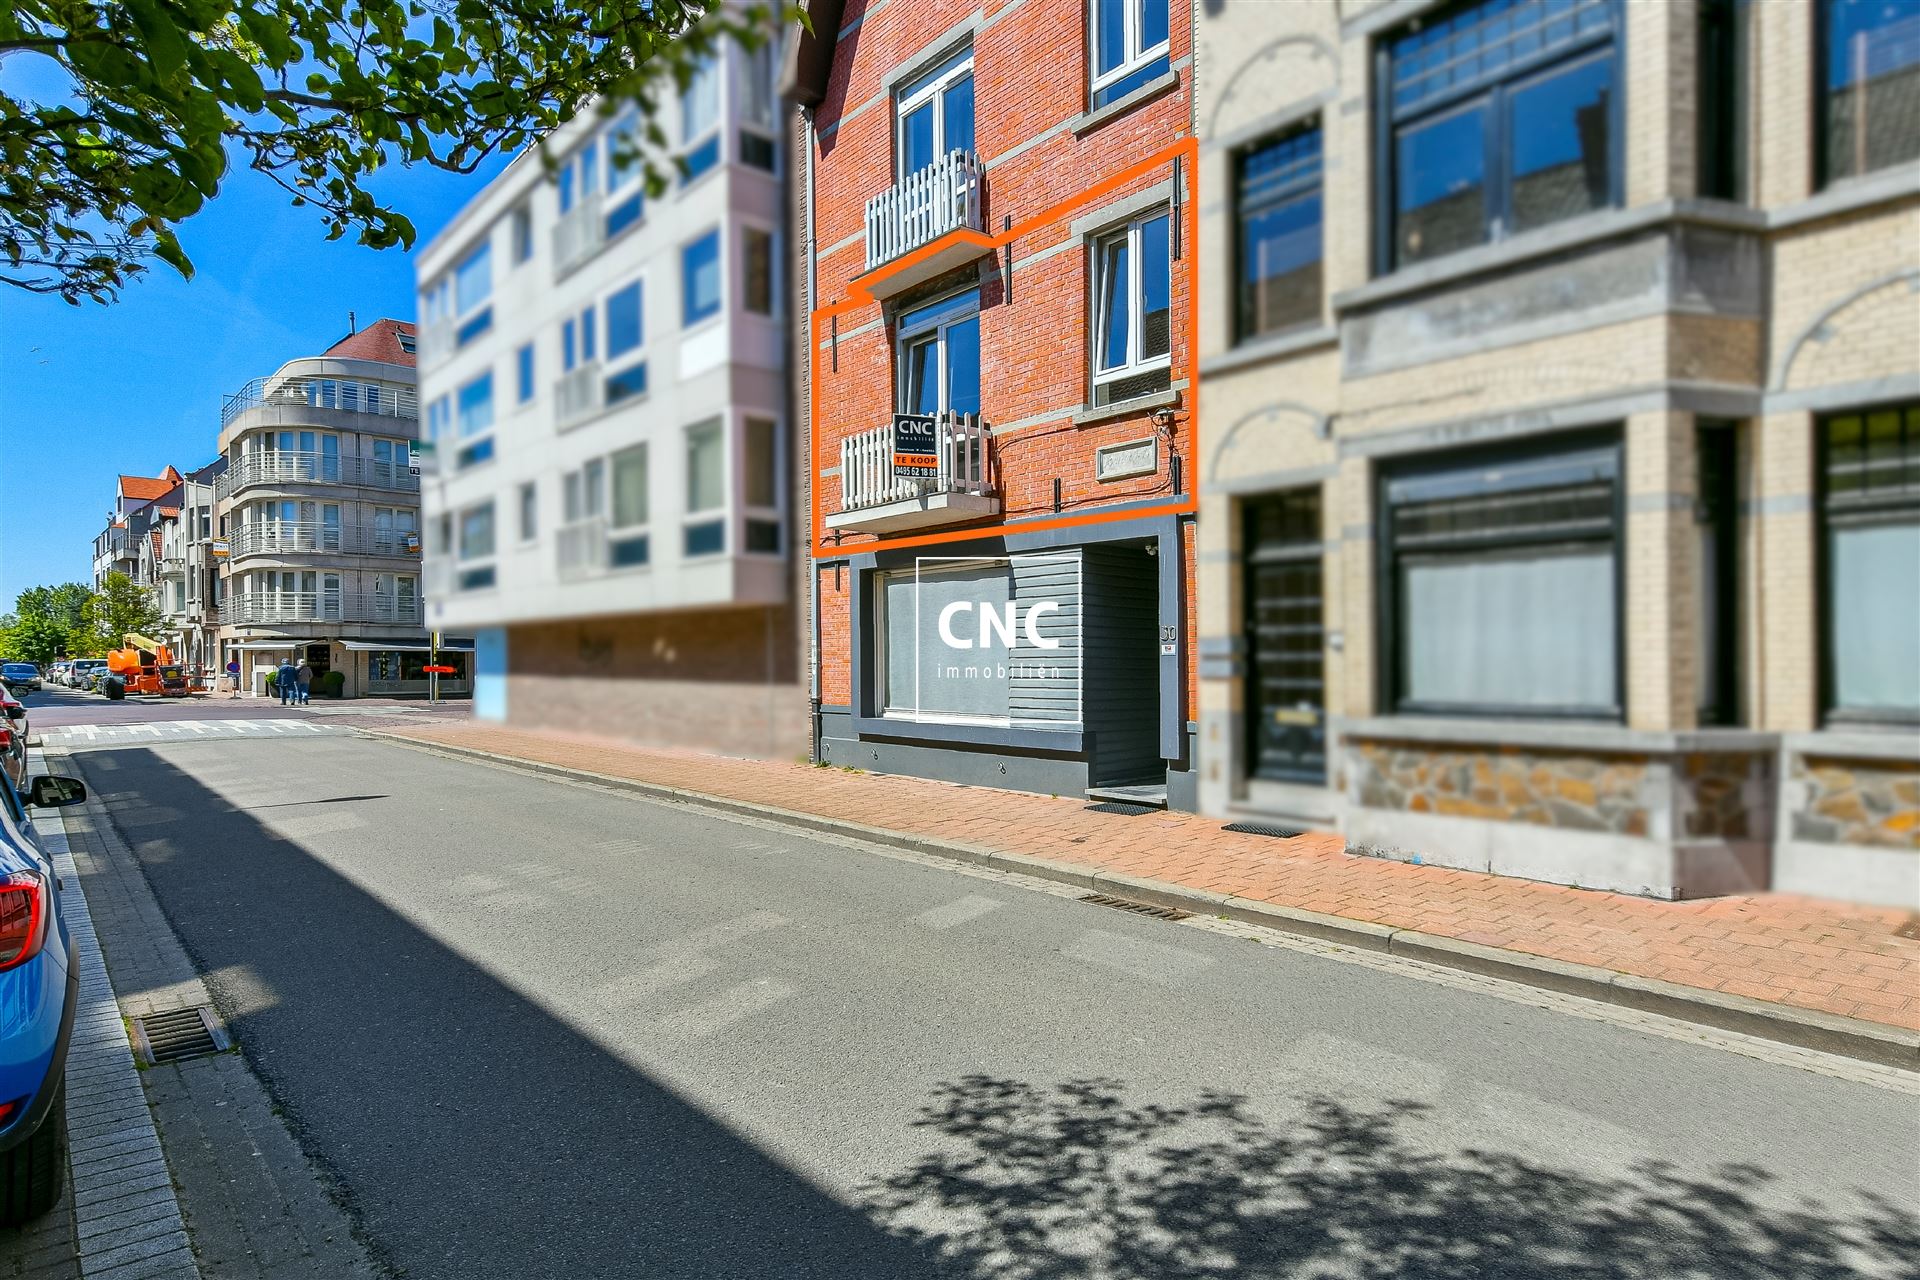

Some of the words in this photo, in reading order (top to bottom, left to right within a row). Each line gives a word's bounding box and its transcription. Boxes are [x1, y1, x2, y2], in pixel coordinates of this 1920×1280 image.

[898, 420, 932, 434] CNC
[895, 466, 910, 476] 0495
[911, 466, 920, 476] 62
[921, 467, 928, 476] 18
